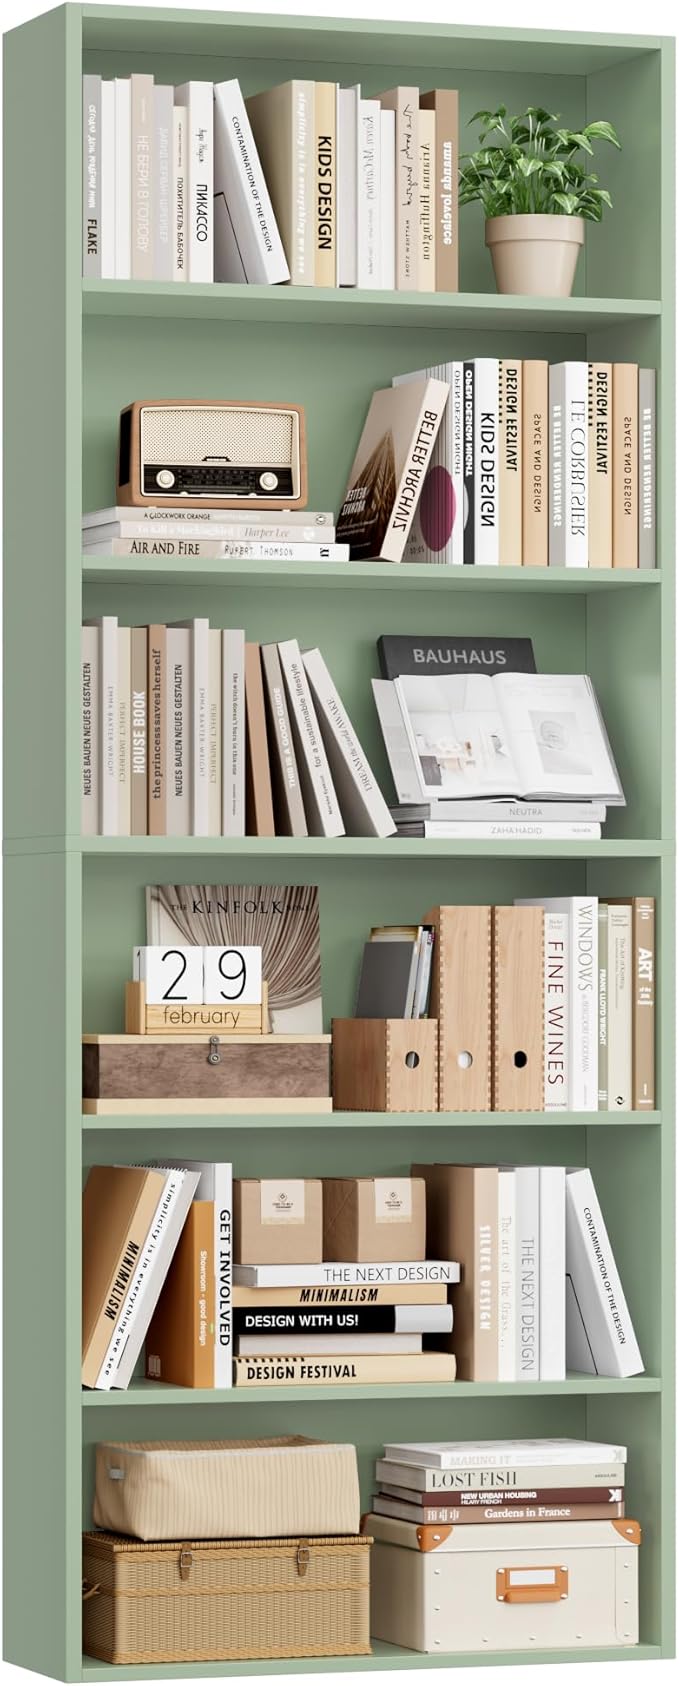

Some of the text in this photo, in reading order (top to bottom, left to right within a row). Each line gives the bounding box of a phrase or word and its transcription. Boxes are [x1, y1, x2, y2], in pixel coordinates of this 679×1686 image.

[137, 136, 148, 153] НЕ
[232, 117, 273, 252] CONTAMINATION OF THE DESIGN
[318, 136, 332, 250] KIDS DESIGN
[196, 184, 208, 242] ПИКАССО
[87, 218, 97, 255] FLAKE
[186, 513, 211, 521] ORANGE
[130, 541, 200, 556] AIR AND FIRE
[413, 649, 506, 665] BAUHAUS
[290, 663, 304, 696] lifestyle
[274, 687, 284, 716] GUIDE
[83, 662, 92, 796] NEUES BAUEN NEUES GESTALTEN
[133, 691, 145, 773] HOUSE BOOK
[278, 717, 289, 746] GOOD
[298, 698, 317, 745] sustainable
[175, 740, 183, 768] BAUEN
[313, 756, 322, 767] for
[175, 770, 183, 796] NEUES
[509, 808, 543, 816] NEUTRA
[192, 900, 285, 914] KINFOLK
[578, 905, 593, 991] WINDOWS
[548, 942, 564, 993] FINE
[638, 947, 653, 981] ART
[162, 1005, 240, 1029] february
[548, 1006, 564, 1085] WINES
[104, 1241, 140, 1321] MINIMALISM
[105, 1183, 176, 1376] simplicity is in everything we see
[219, 1209, 231, 1346] GET INVOLVED
[324, 1266, 451, 1282] THE NEXT DESIGN
[479, 1225, 491, 1330] SILVER DESIGN
[583, 1207, 626, 1345] CONTAMINATION OF THE DESIGN
[199, 1250, 208, 1346] Showroom good design
[300, 1288, 379, 1302] MINIMALISM
[521, 1239, 535, 1371] THE NEXT DESIGN
[245, 1314, 359, 1328] DESIGN WITH US!
[247, 1364, 357, 1380] DESIGN FESTIVAL
[450, 1456, 493, 1466] MAKING
[432, 1471, 517, 1488] LOST FISH
[478, 1492, 503, 1500] URBAN
[504, 1491, 537, 1499] HOUSING
[484, 1507, 571, 1519] Gardens in France
